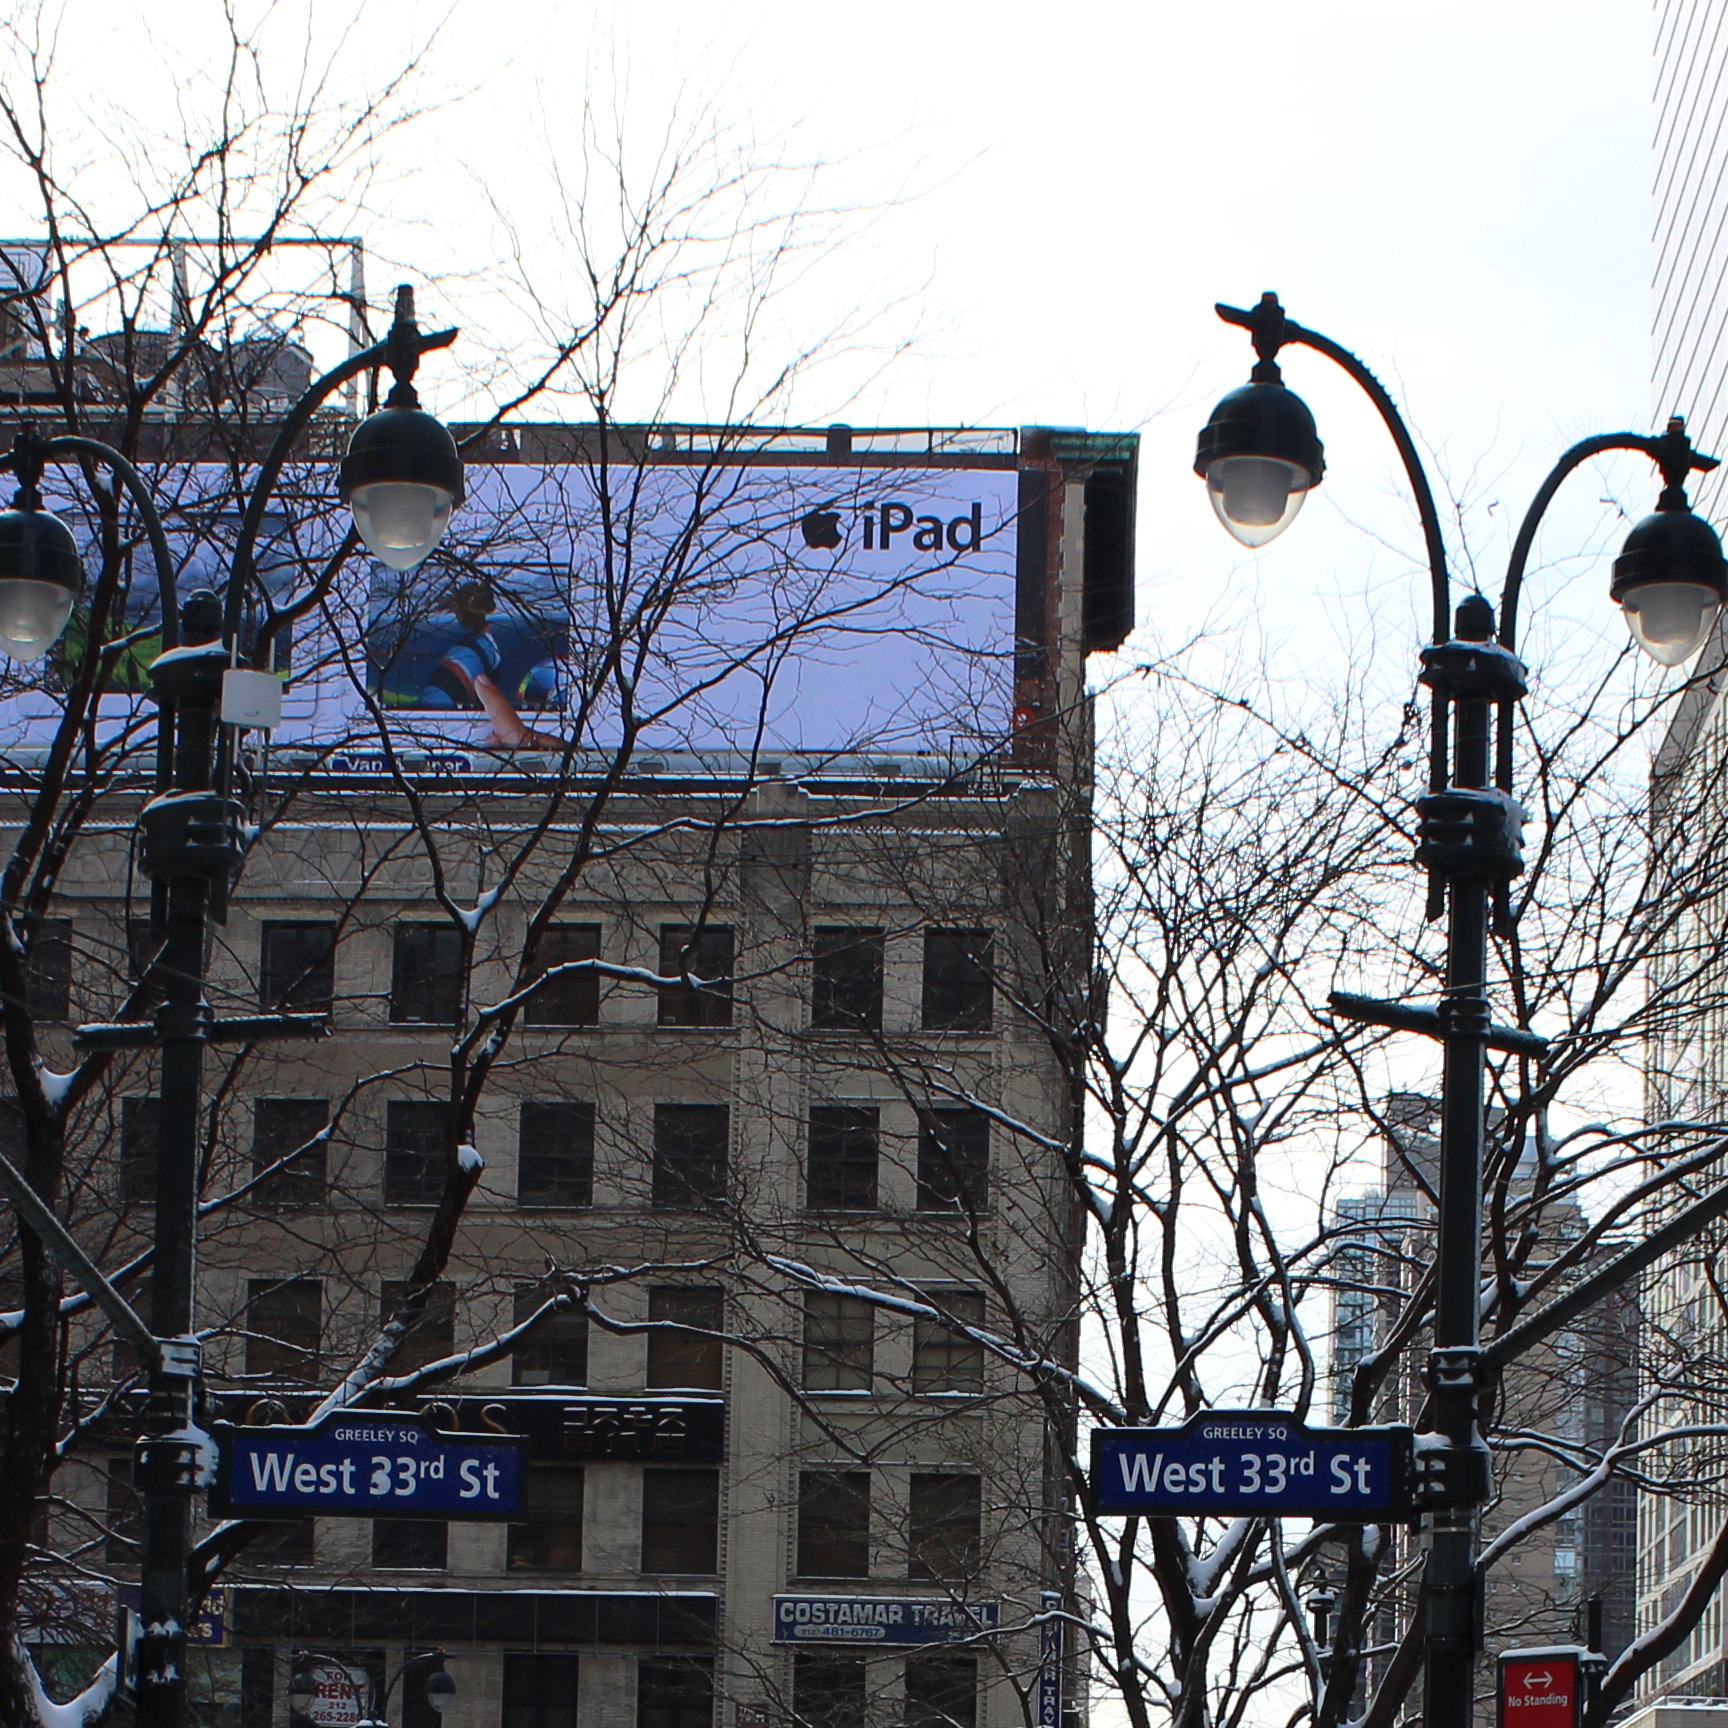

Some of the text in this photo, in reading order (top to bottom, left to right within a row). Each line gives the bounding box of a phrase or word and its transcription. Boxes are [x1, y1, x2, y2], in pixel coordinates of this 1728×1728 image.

[863, 502, 982, 551] iPad
[334, 1428, 419, 1445] GREELEY SQ
[1203, 1426, 1288, 1442] GREELEY SQ
[249, 1452, 500, 1499] West 33rd St
[1118, 1450, 1371, 1495] West 33rd St
[779, 1602, 904, 1625] COSTAMAR
[821, 1627, 881, 1638] 481-6767
[1508, 1693, 1568, 1707] No Standing
